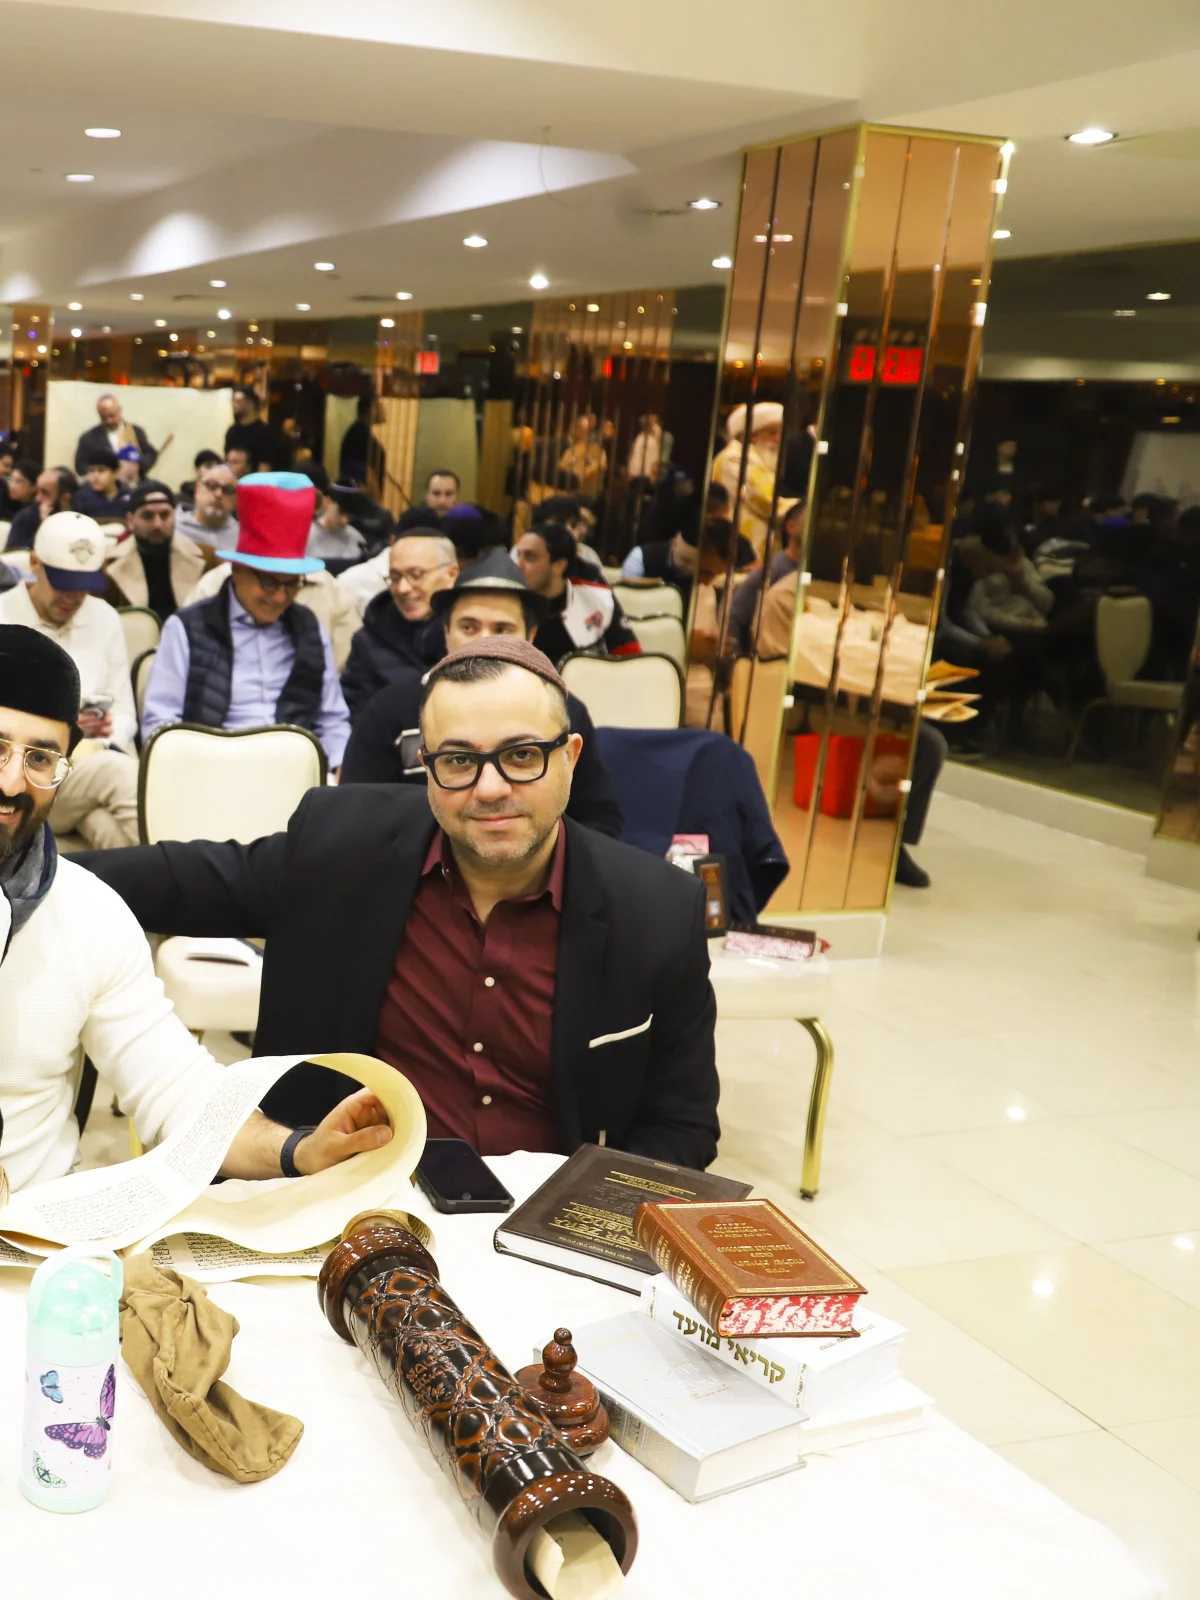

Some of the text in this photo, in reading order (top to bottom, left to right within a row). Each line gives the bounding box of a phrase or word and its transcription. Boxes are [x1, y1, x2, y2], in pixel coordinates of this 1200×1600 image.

[554, 1216, 602, 1236] ZERA
[672, 1309, 722, 1351] מועד
[726, 1337, 787, 1384] קריאי
